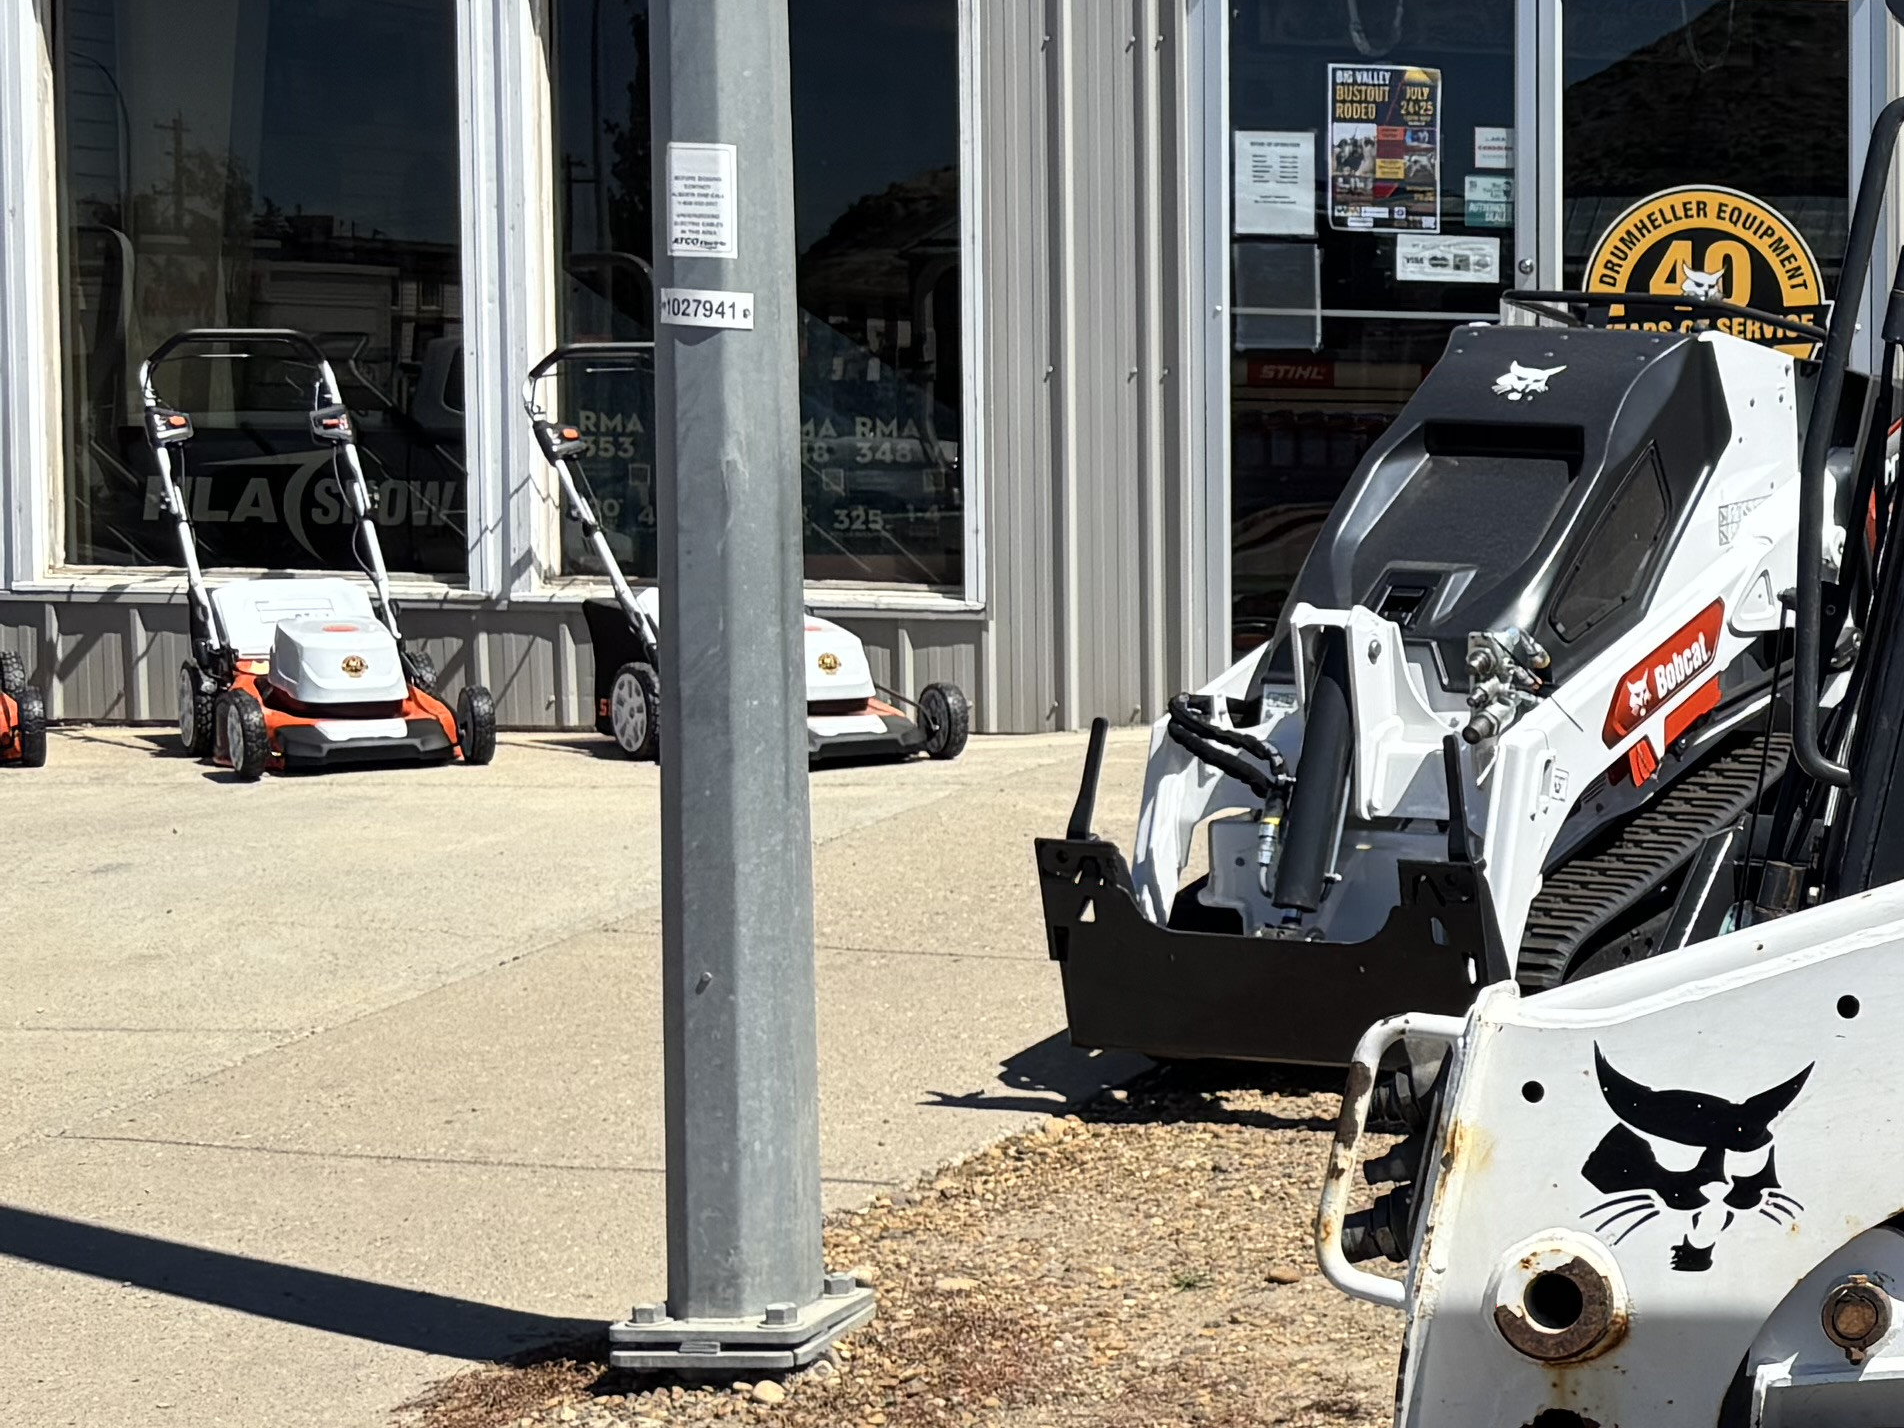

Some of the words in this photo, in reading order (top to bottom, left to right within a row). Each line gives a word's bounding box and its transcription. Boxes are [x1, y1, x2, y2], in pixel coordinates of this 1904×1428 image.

[1356, 70, 1391, 85] VALLEY
[1336, 85, 1390, 102] BUSTOUT
[1406, 86, 1430, 100] JULY
[1336, 103, 1377, 120] RODEO
[1599, 201, 1708, 288] DRUMHELLER
[1716, 202, 1808, 291] EQUIPMENT
[667, 298, 735, 320] 1027941
[1260, 365, 1324, 380] STIHL
[579, 410, 644, 433] RMA
[855, 417, 921, 439] RMA
[1654, 632, 1709, 699] Bobcat
